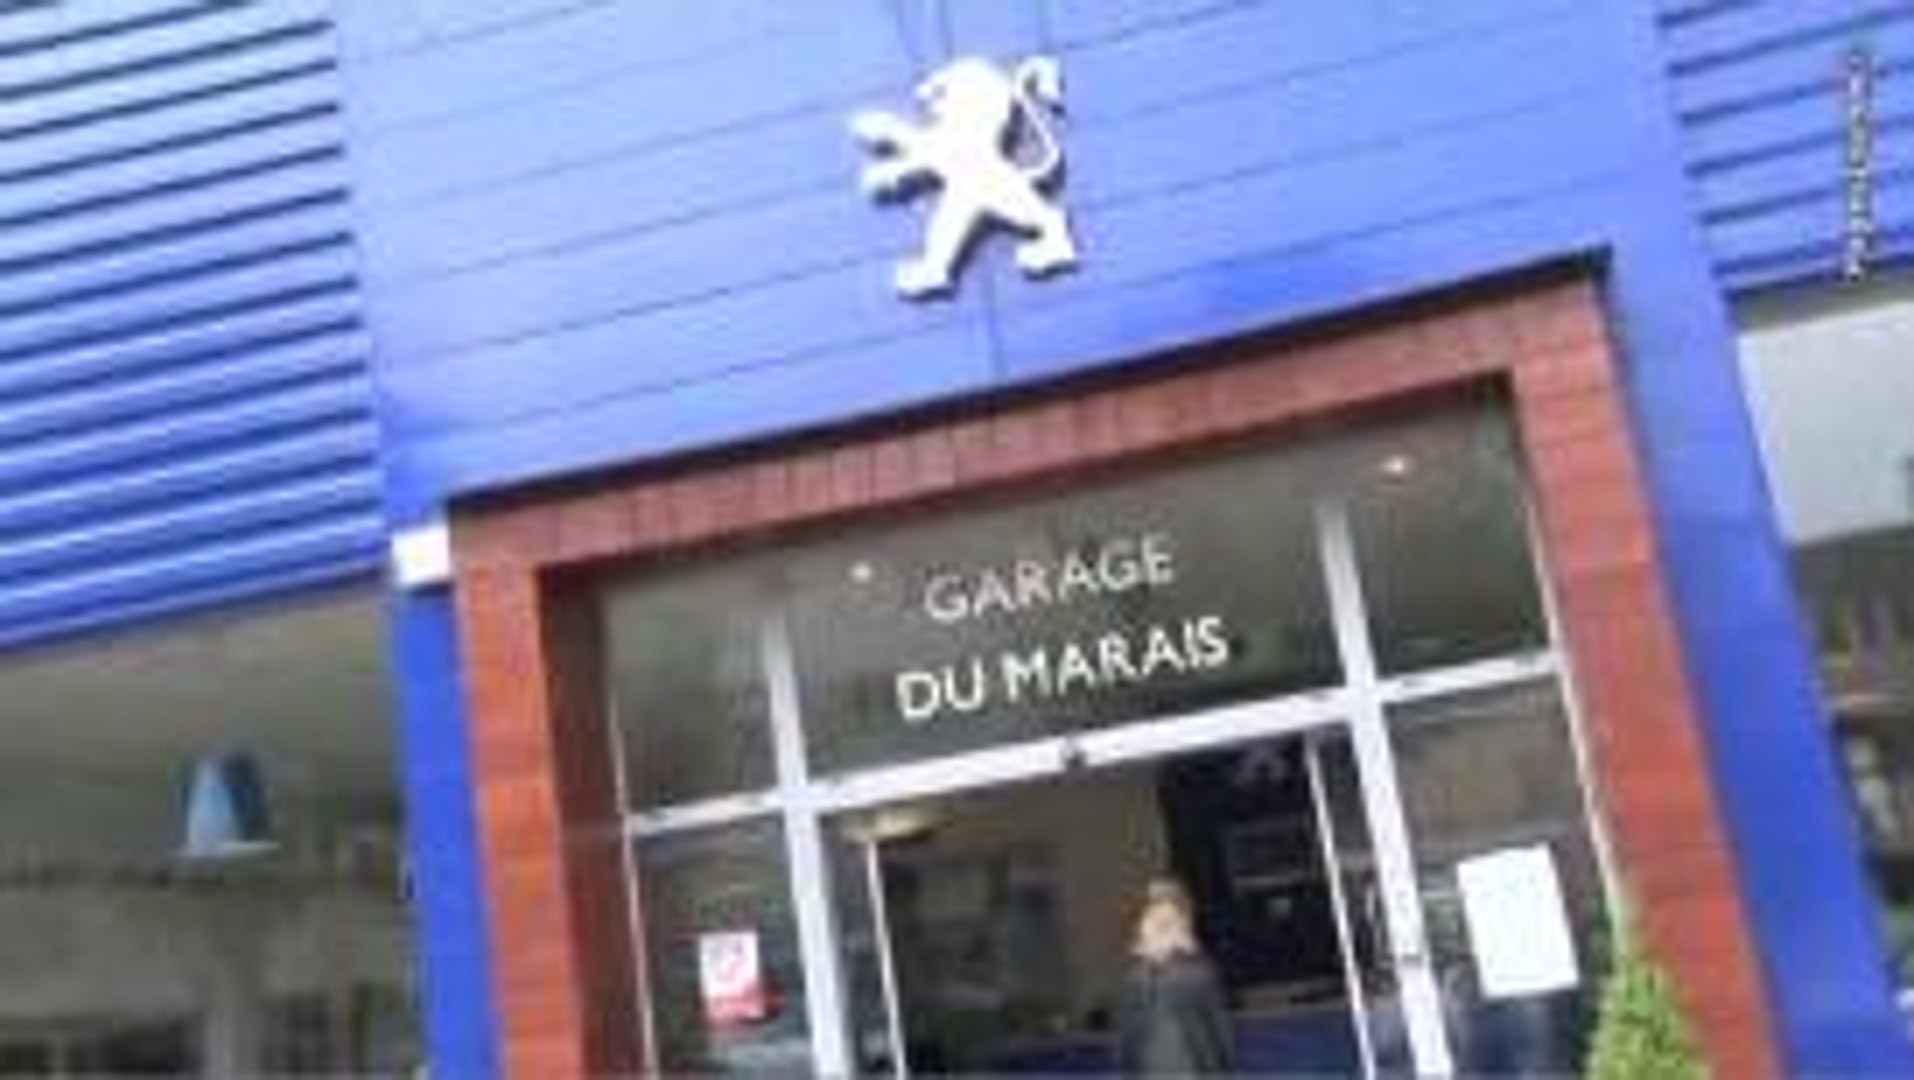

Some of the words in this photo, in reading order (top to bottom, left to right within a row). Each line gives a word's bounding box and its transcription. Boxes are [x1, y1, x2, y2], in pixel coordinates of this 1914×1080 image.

[923, 532, 1174, 622] GARAGE
[896, 656, 984, 721] DU
[1002, 615, 1229, 702] MARAIS
